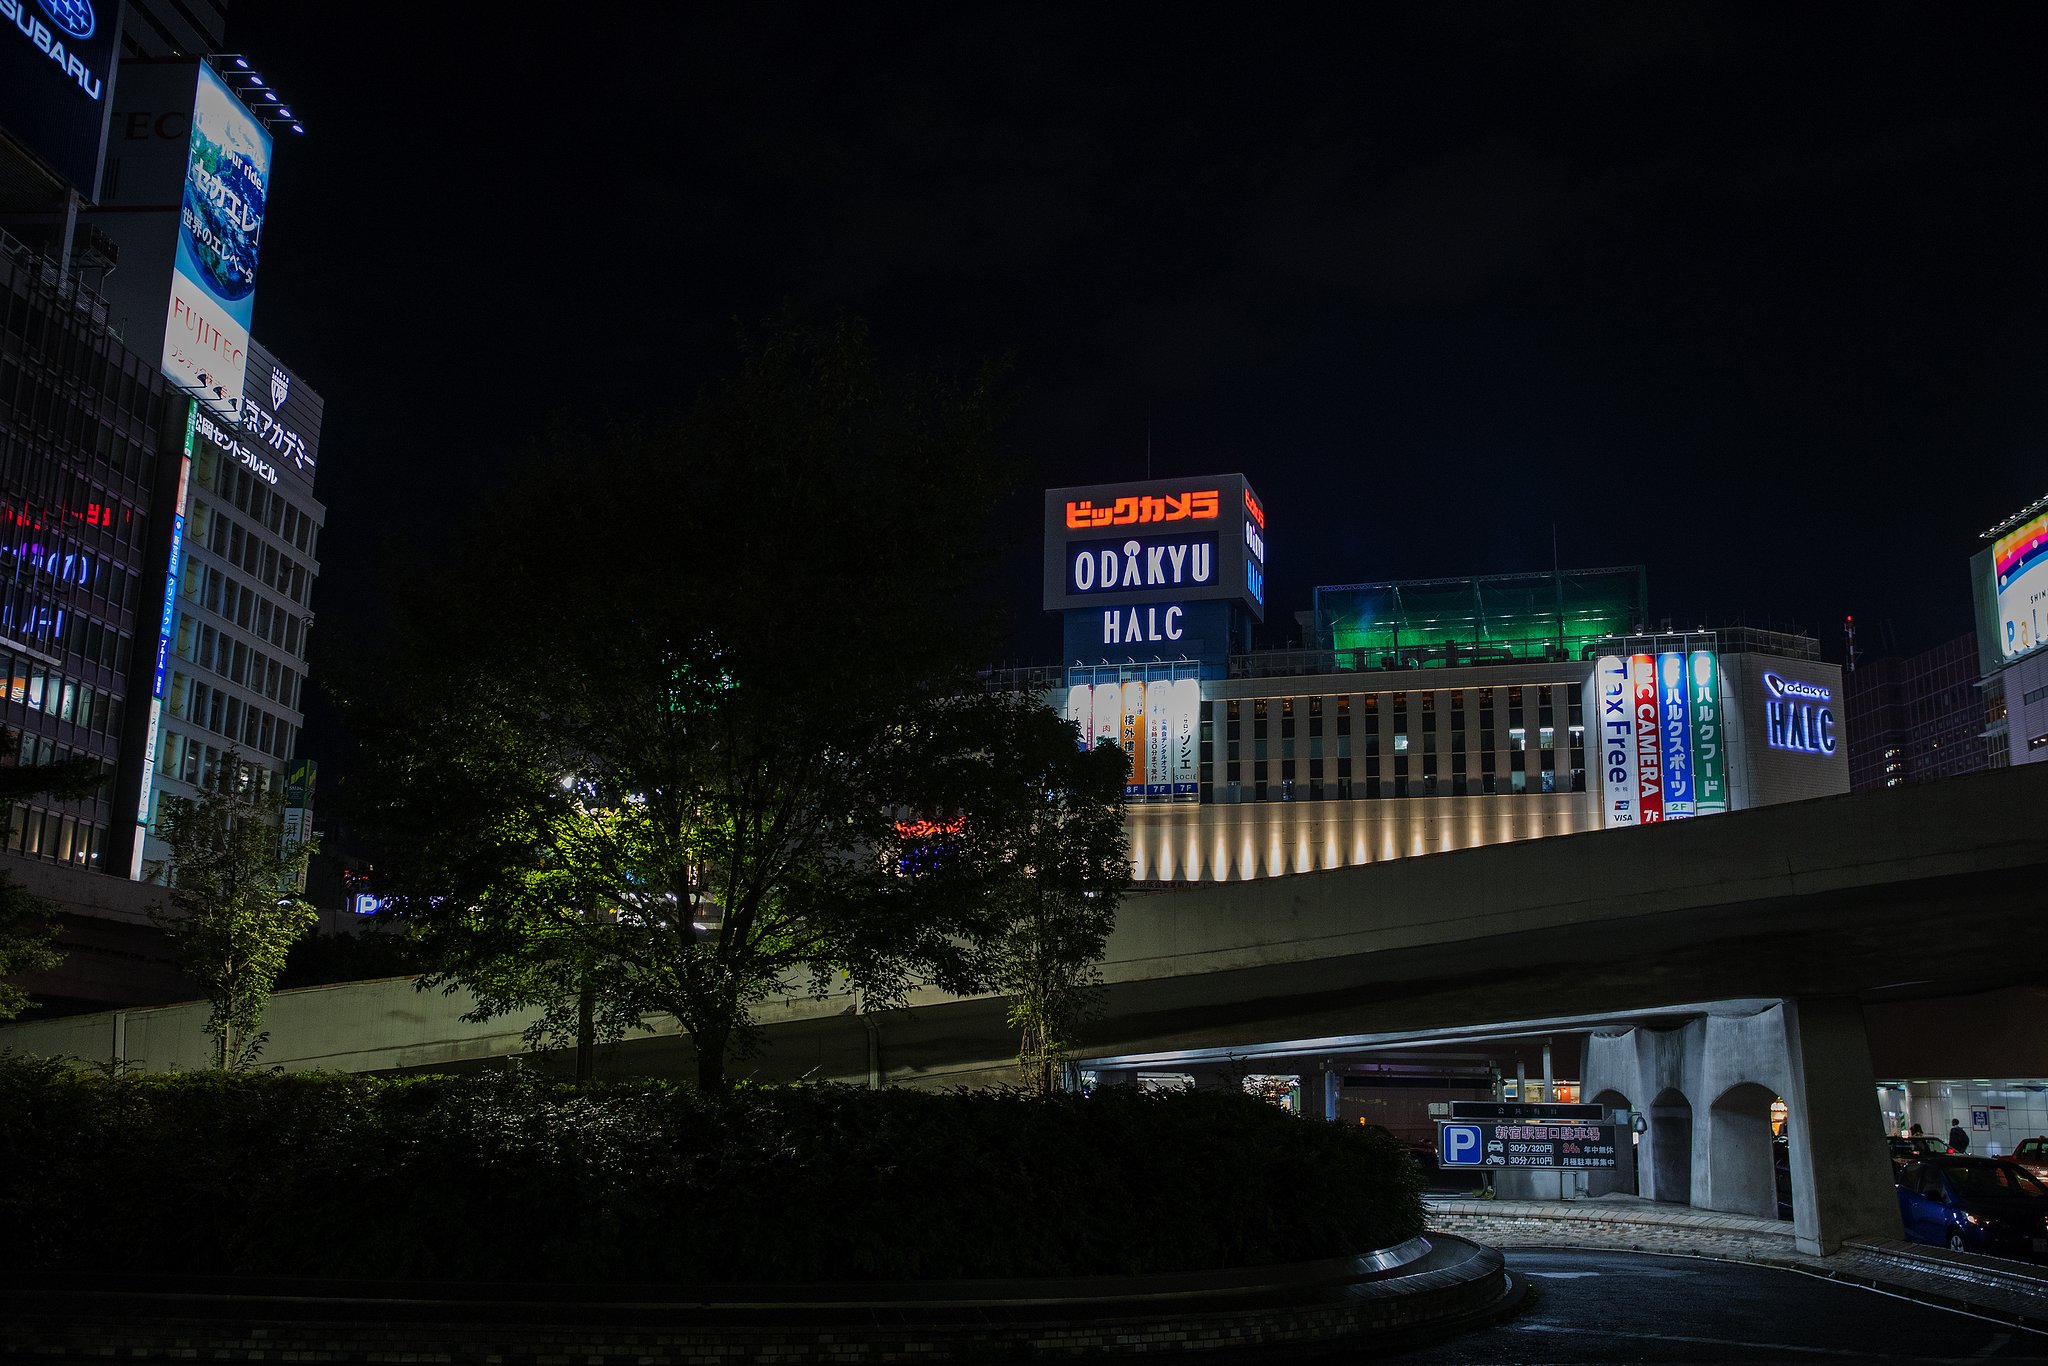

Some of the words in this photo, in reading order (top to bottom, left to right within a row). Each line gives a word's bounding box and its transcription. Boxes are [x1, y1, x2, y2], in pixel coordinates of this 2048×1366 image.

[0, 0, 101, 100] SUBARU
[112, 111, 185, 140] EC
[173, 296, 244, 372] FUJITEC
[240, 395, 316, 470] 京アカデミー
[1066, 489, 1220, 529] ビックカメラ
[1074, 540, 1210, 591] ODAKYU
[2030, 588, 2048, 605] SHIN
[1103, 606, 1183, 644] HALC
[2006, 608, 2048, 651] Pal
[1605, 663, 1628, 715] Tax
[1665, 688, 1687, 797] ハルクスポーツ
[1696, 687, 1719, 797] ハルクフード
[1768, 701, 1837, 753] HALC
[1180, 735, 1192, 769] ソシエ
[1606, 721, 1631, 783] Free
[1637, 703, 1659, 798] CAMERA
[1614, 814, 1633, 822] VISA
[1643, 809, 1659, 822] 7F
[1671, 803, 1687, 811] 2F
[1450, 1128, 1476, 1161] P
[1495, 1126, 1600, 1141] 新宿駅西口駐車場
[1510, 1144, 1553, 1153] 30分/320円
[1510, 1156, 1553, 1166] 30分/210円
